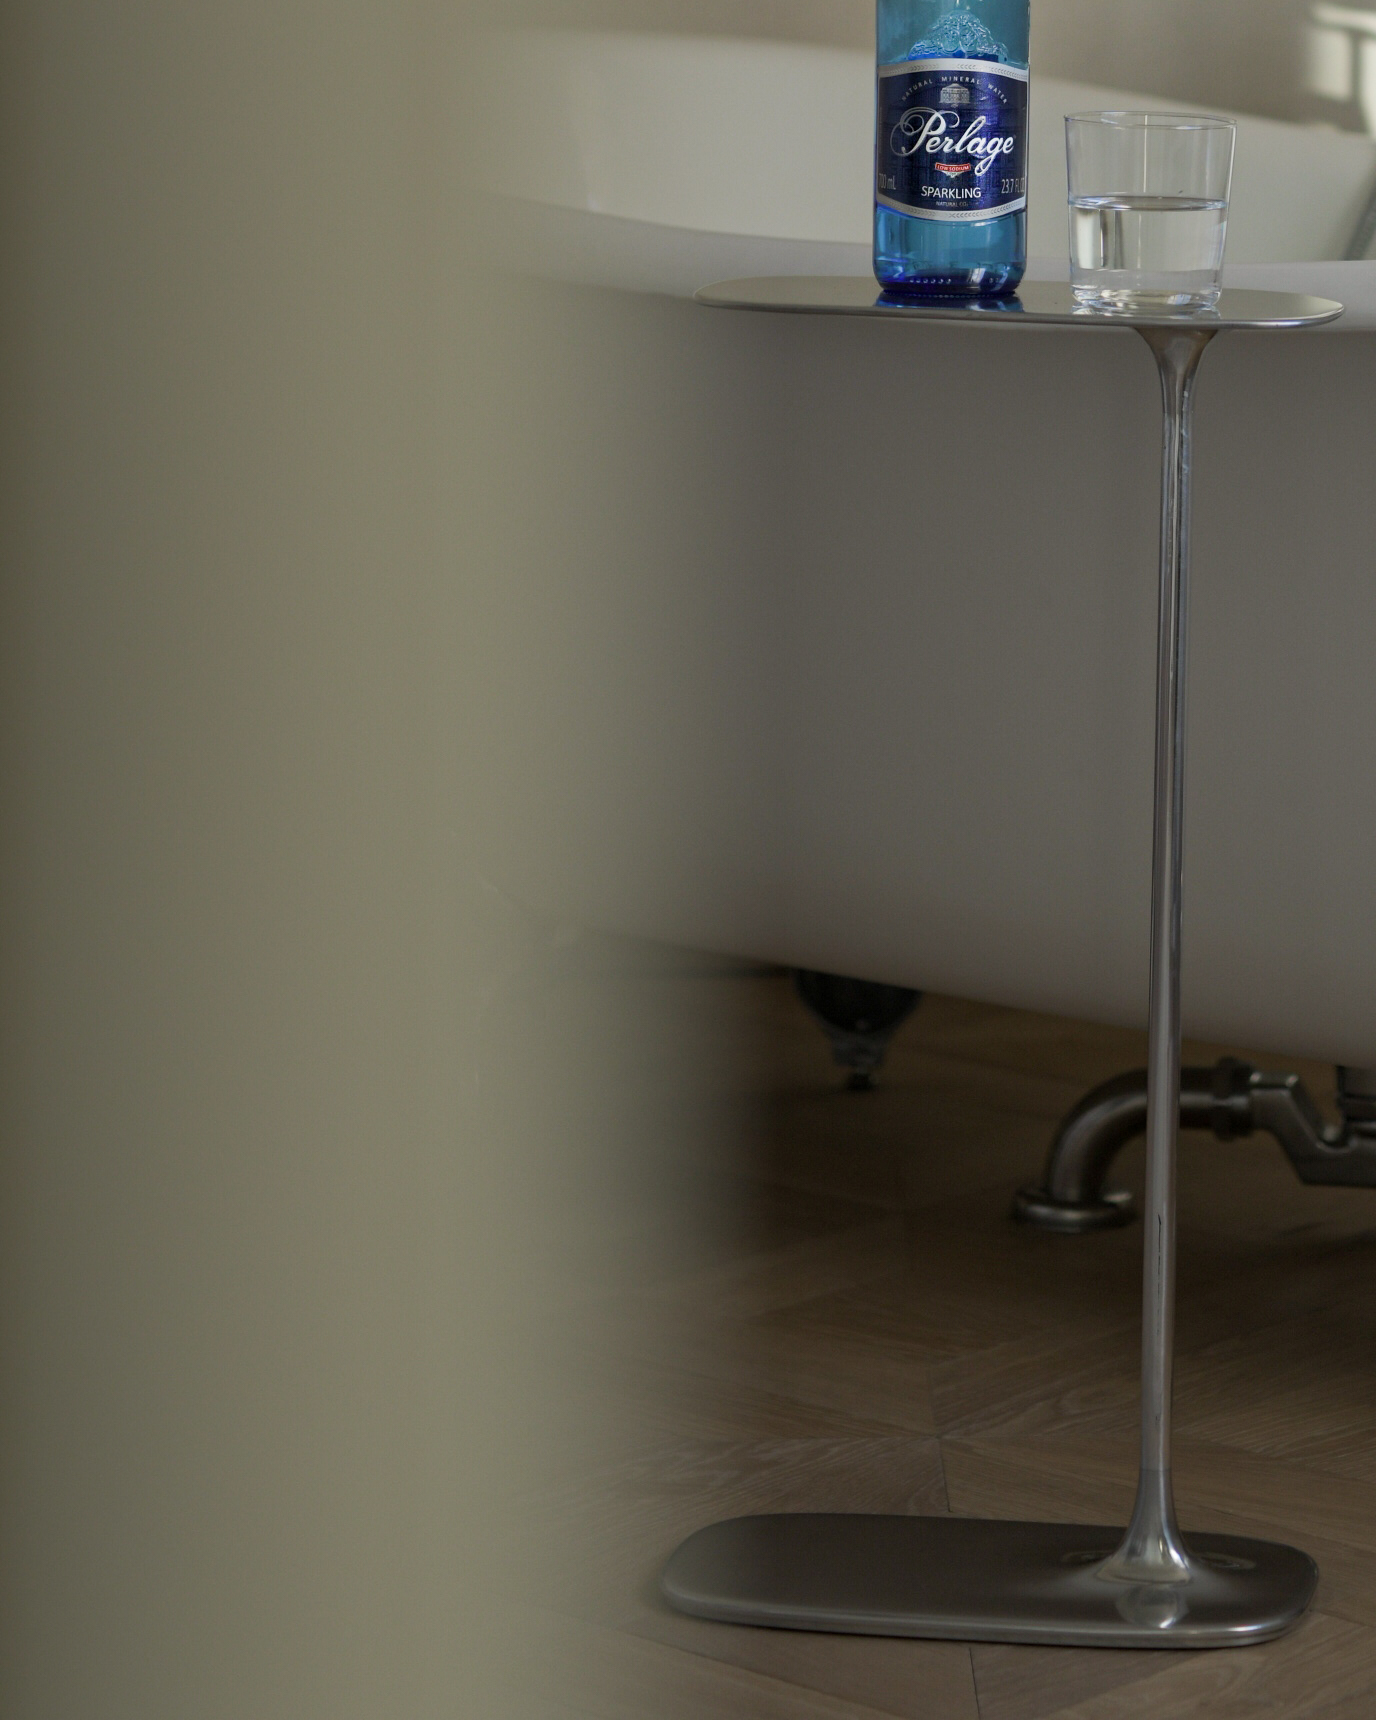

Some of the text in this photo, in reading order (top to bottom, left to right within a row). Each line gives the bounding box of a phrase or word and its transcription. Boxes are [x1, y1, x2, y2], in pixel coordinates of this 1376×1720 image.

[902, 76, 1008, 104] NATURAL MINERAL WATER
[890, 106, 1015, 177] Perlage
[921, 185, 982, 199] SPARKLING
